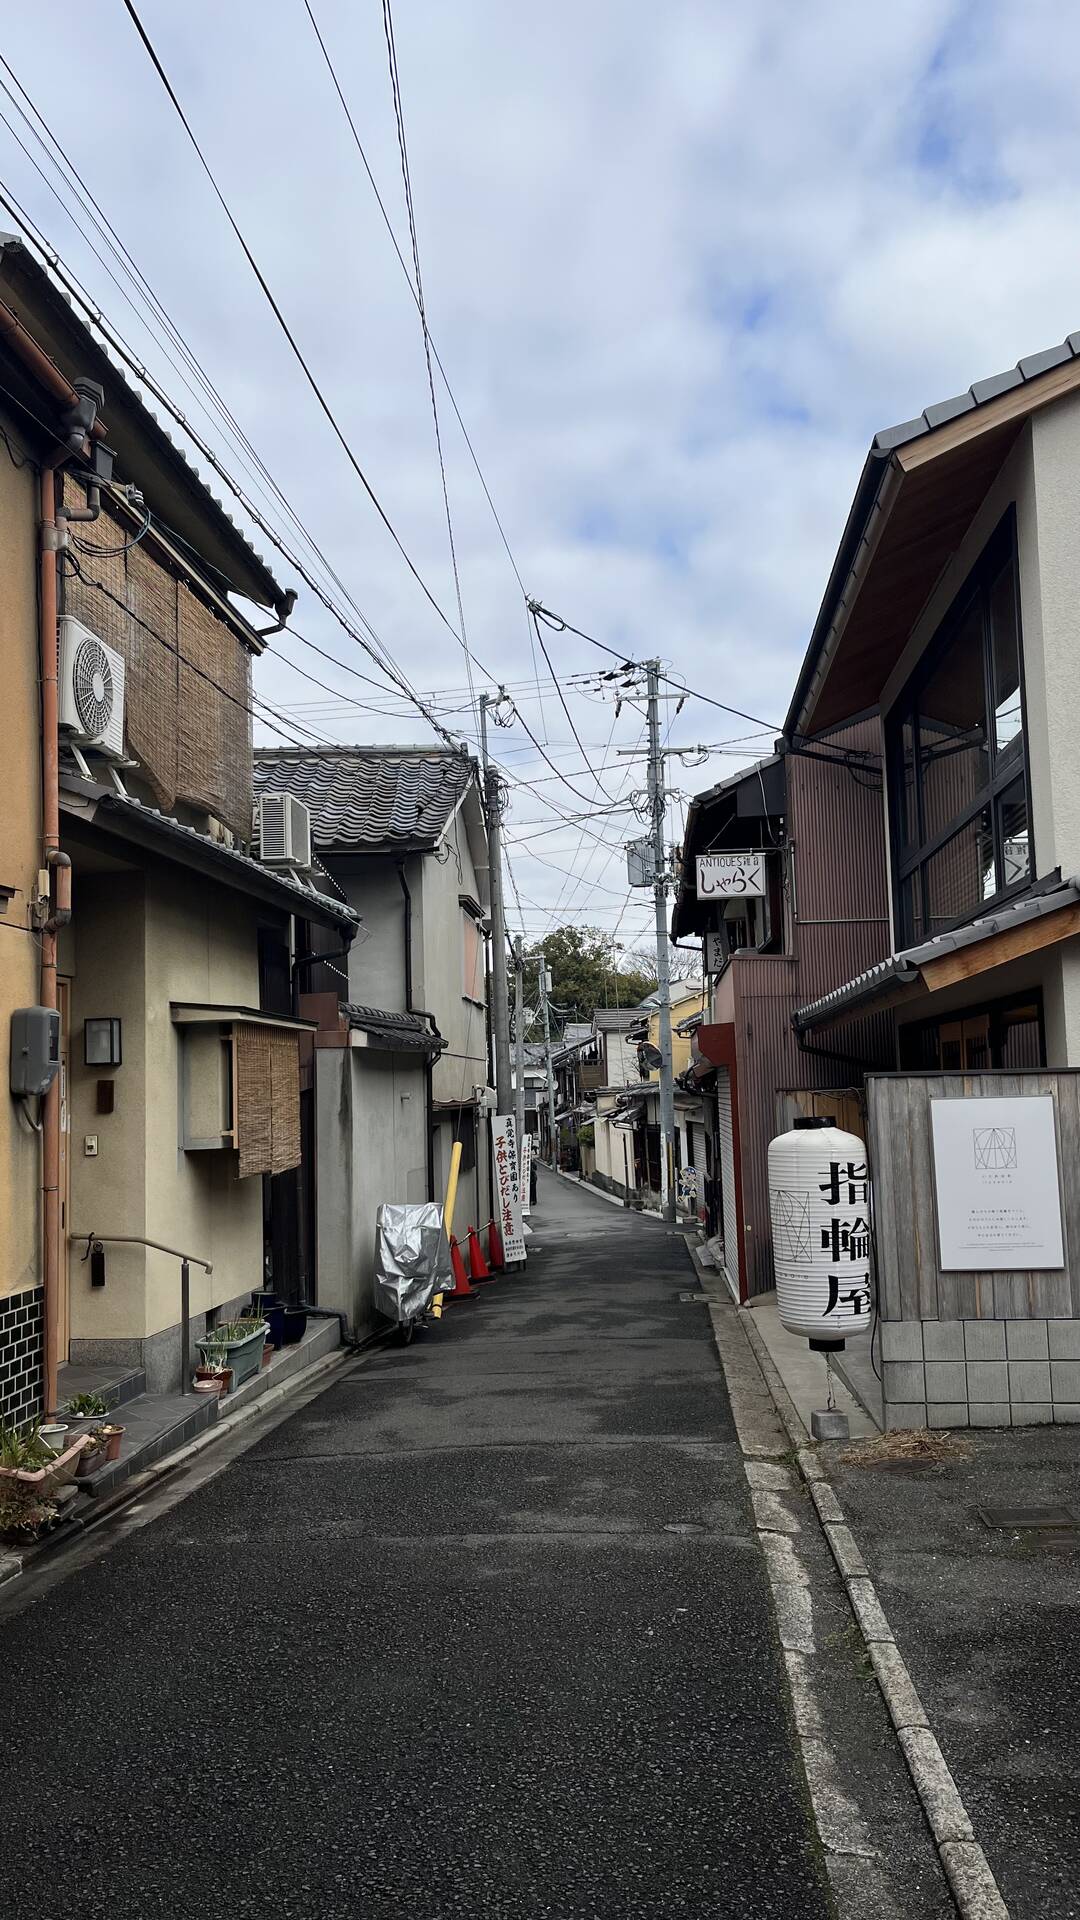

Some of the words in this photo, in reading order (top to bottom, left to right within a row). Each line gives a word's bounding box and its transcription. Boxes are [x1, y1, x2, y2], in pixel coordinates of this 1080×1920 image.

[700, 857, 742, 868] ANTIQUES
[700, 867, 761, 894] しゃらく
[495, 1136, 514, 1236] 子供とびだし注意
[818, 1162, 872, 1317] 指輪屋
